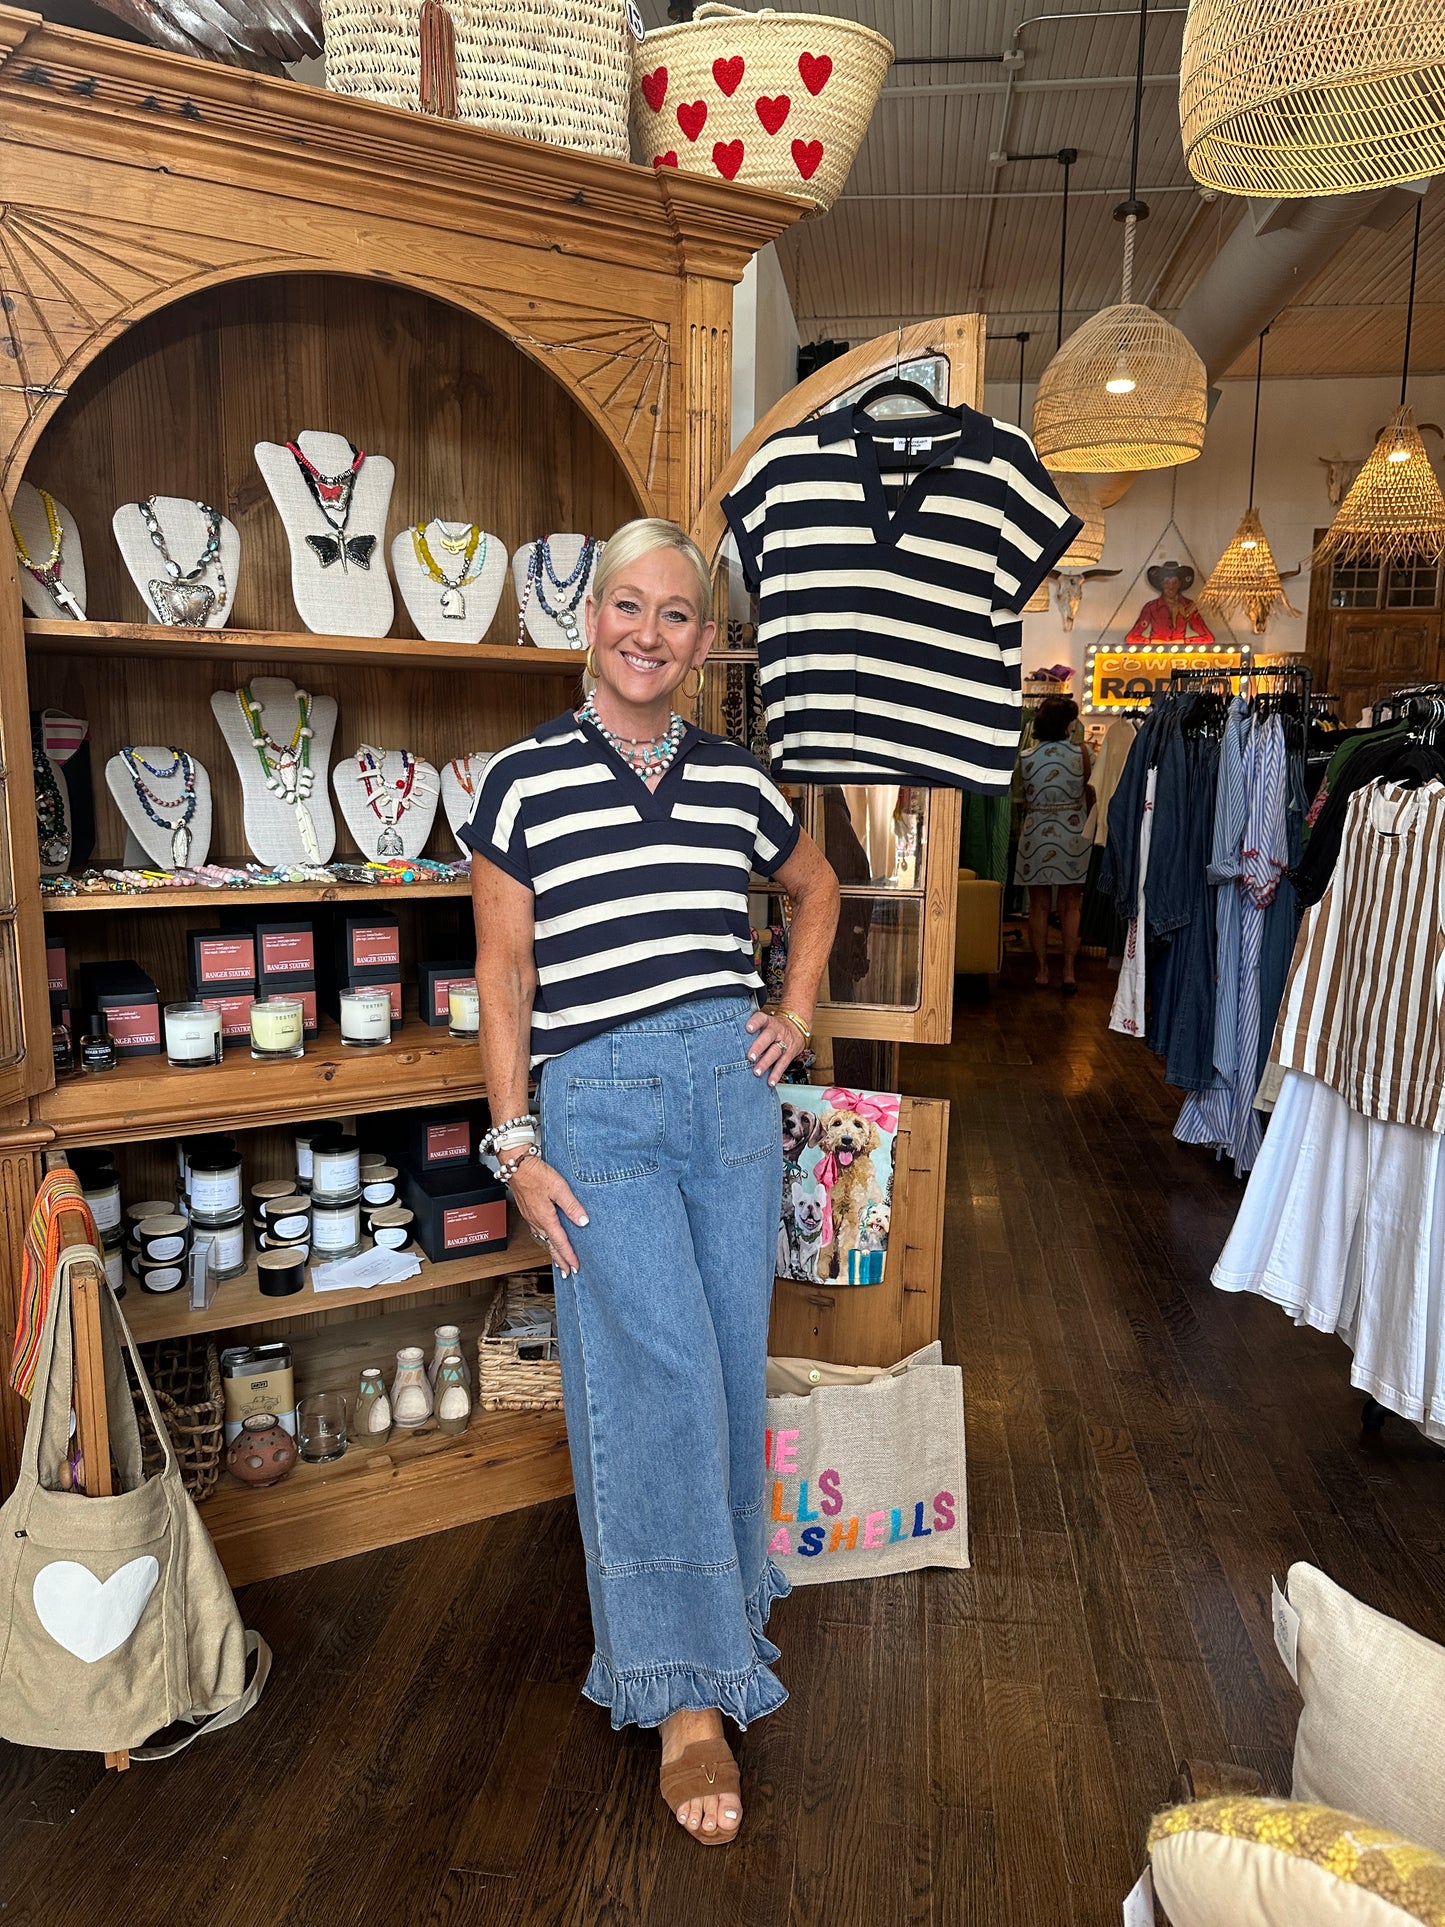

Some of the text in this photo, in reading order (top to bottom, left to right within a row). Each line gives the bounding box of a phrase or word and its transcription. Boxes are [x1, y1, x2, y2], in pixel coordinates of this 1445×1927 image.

[1101, 657, 1234, 672] COWBOY
[266, 963, 289, 971] RANGER
[289, 961, 311, 970] STATION
[205, 969, 251, 979] RANGER STATION
[132, 1035, 156, 1044] STATION
[430, 1147, 467, 1158] RANGER STATION
[447, 1233, 489, 1247] RANGER STATION
[767, 1490, 956, 1557] ASHELLS
